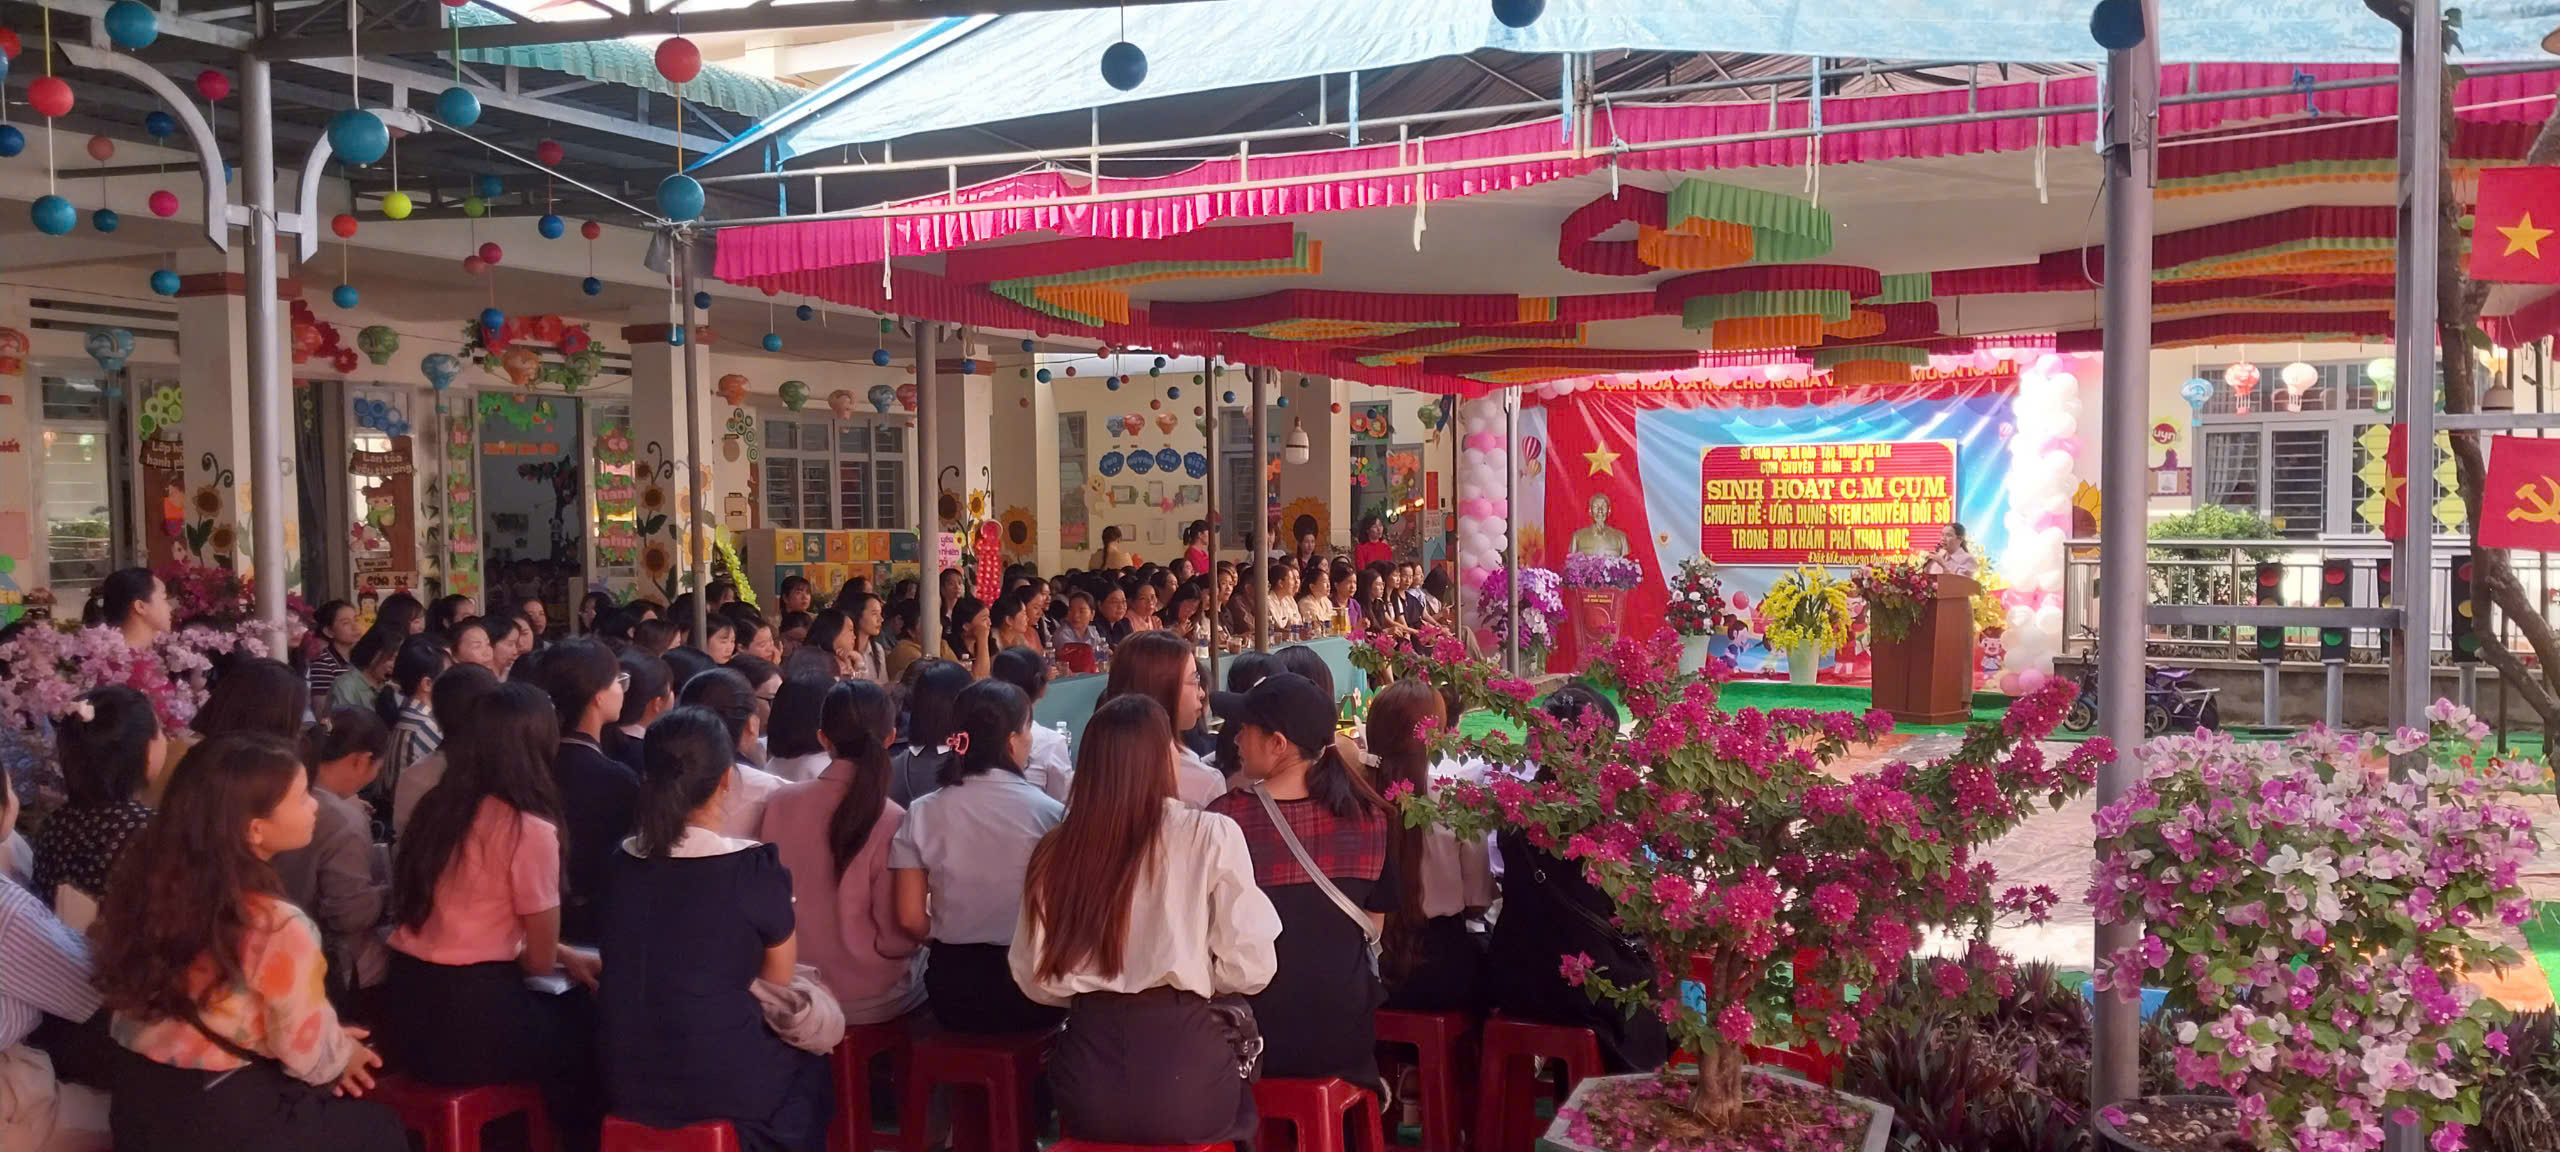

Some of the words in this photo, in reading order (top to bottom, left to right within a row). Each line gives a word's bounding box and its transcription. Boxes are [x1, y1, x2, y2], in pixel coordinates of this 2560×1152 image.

[363, 453, 383, 463] Lan
[1706, 479, 1765, 500] SINH
[1771, 478, 1836, 503] HOẠT
[1840, 477, 1884, 499] C.M
[1889, 476, 1947, 502] CỤM
[1704, 500, 1745, 525] CHUYÊN
[1797, 504, 1827, 529] DỤNG
[1829, 503, 1862, 525] STEM
[1934, 496, 1953, 523] SỐ
[1732, 528, 1769, 549] TRONG
[1773, 528, 1788, 549] HĐ
[1829, 526, 1852, 550] PHÁ
[1854, 528, 1884, 550] KHOA
